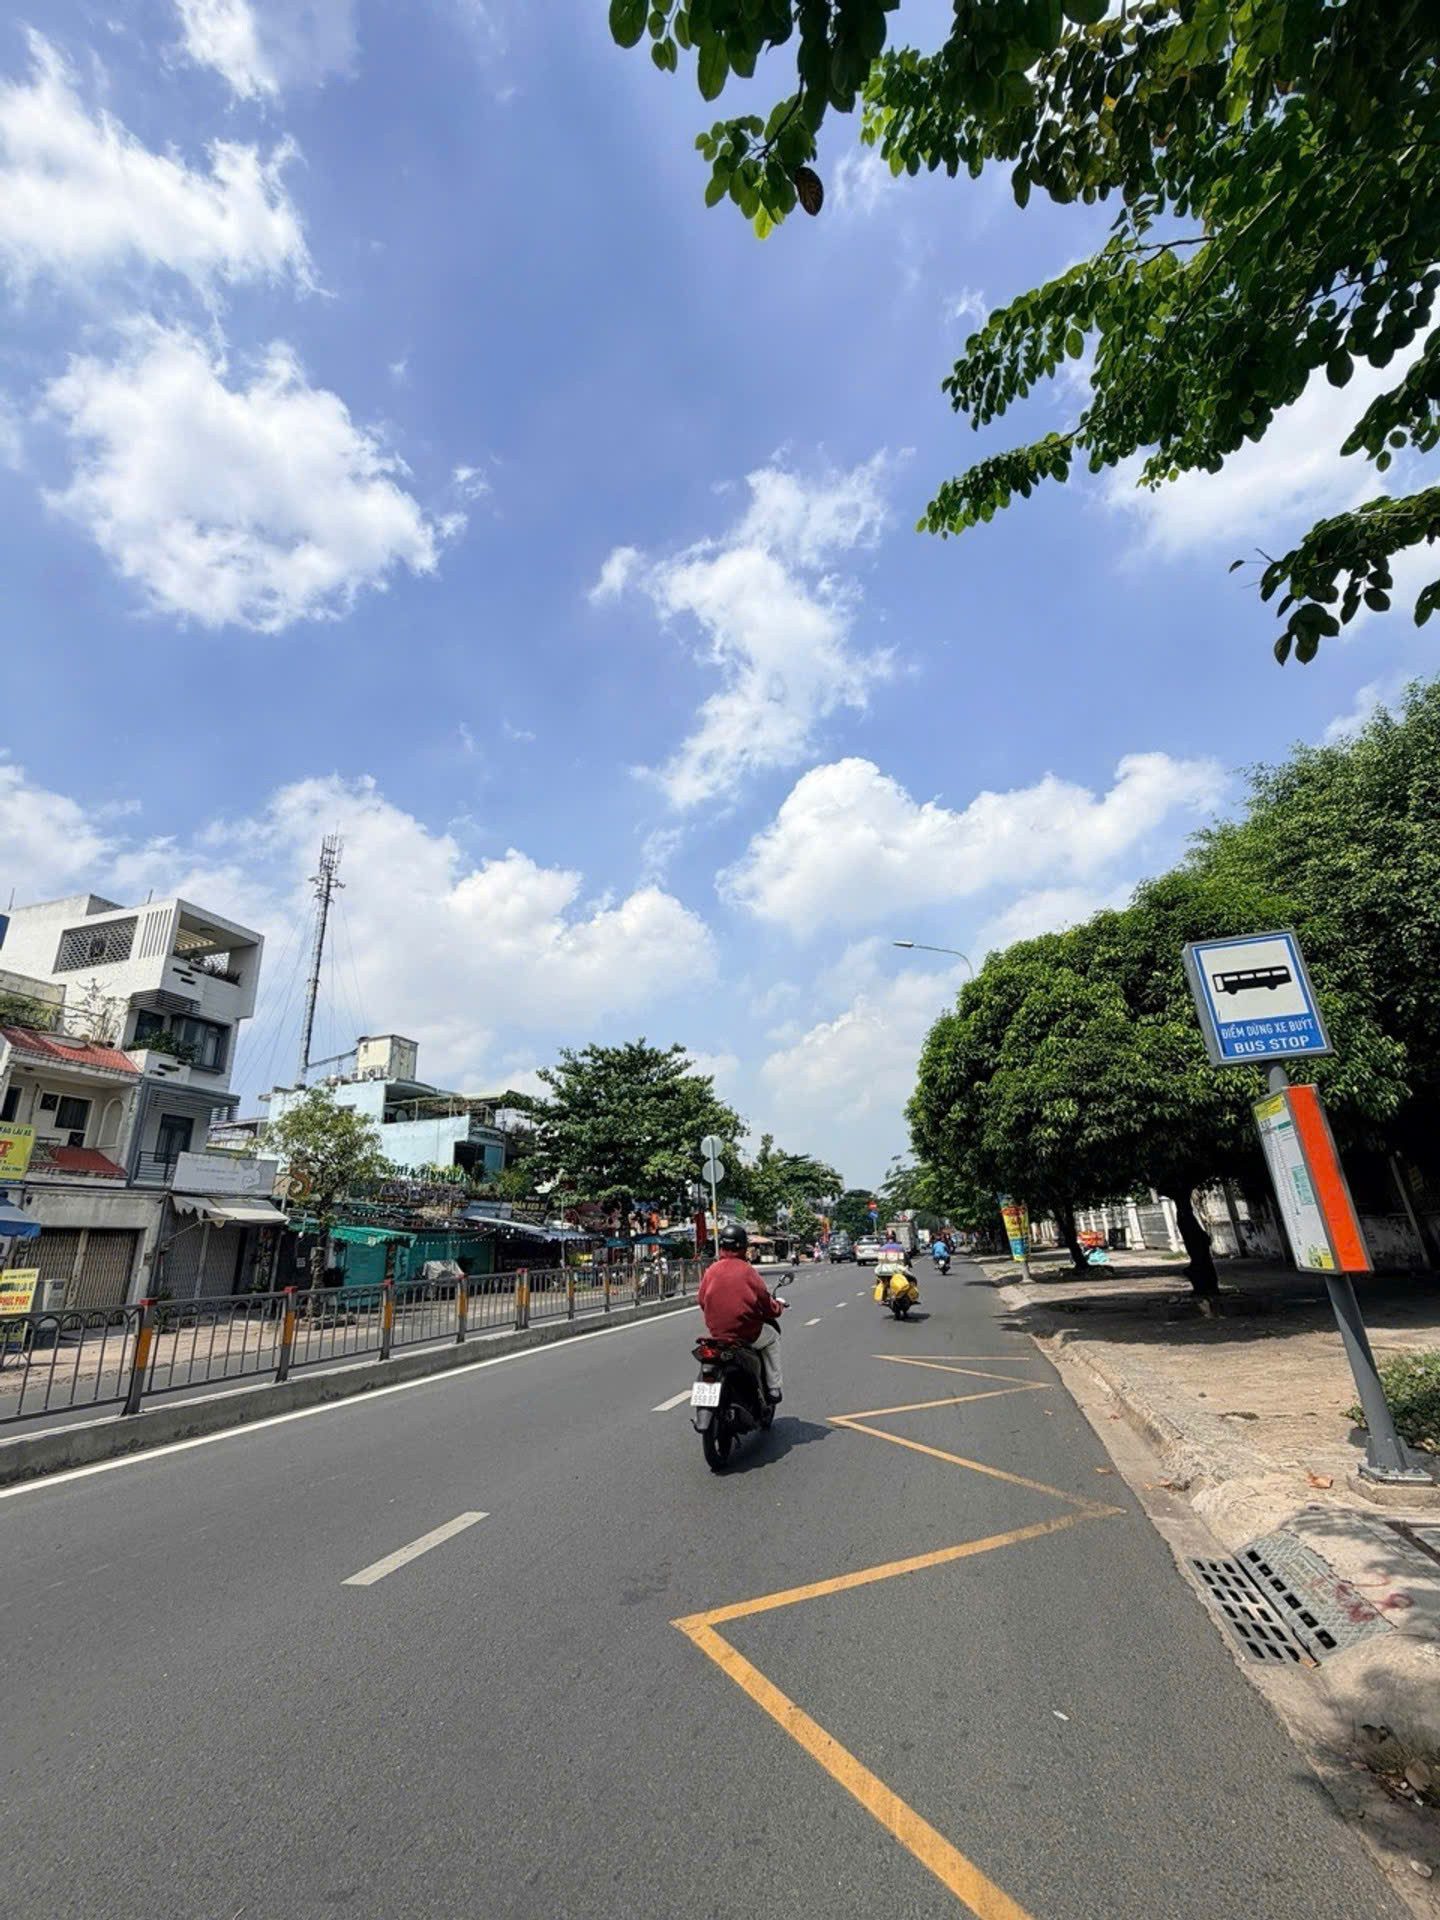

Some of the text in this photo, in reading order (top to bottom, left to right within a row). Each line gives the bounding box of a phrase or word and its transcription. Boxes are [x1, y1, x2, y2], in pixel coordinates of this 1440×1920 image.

[1246, 1022, 1273, 1037] DỪNG
[1274, 1021, 1288, 1033] XE
[1288, 1018, 1313, 1032] BUÝT
[1234, 1035, 1310, 1054] BUS STOP
